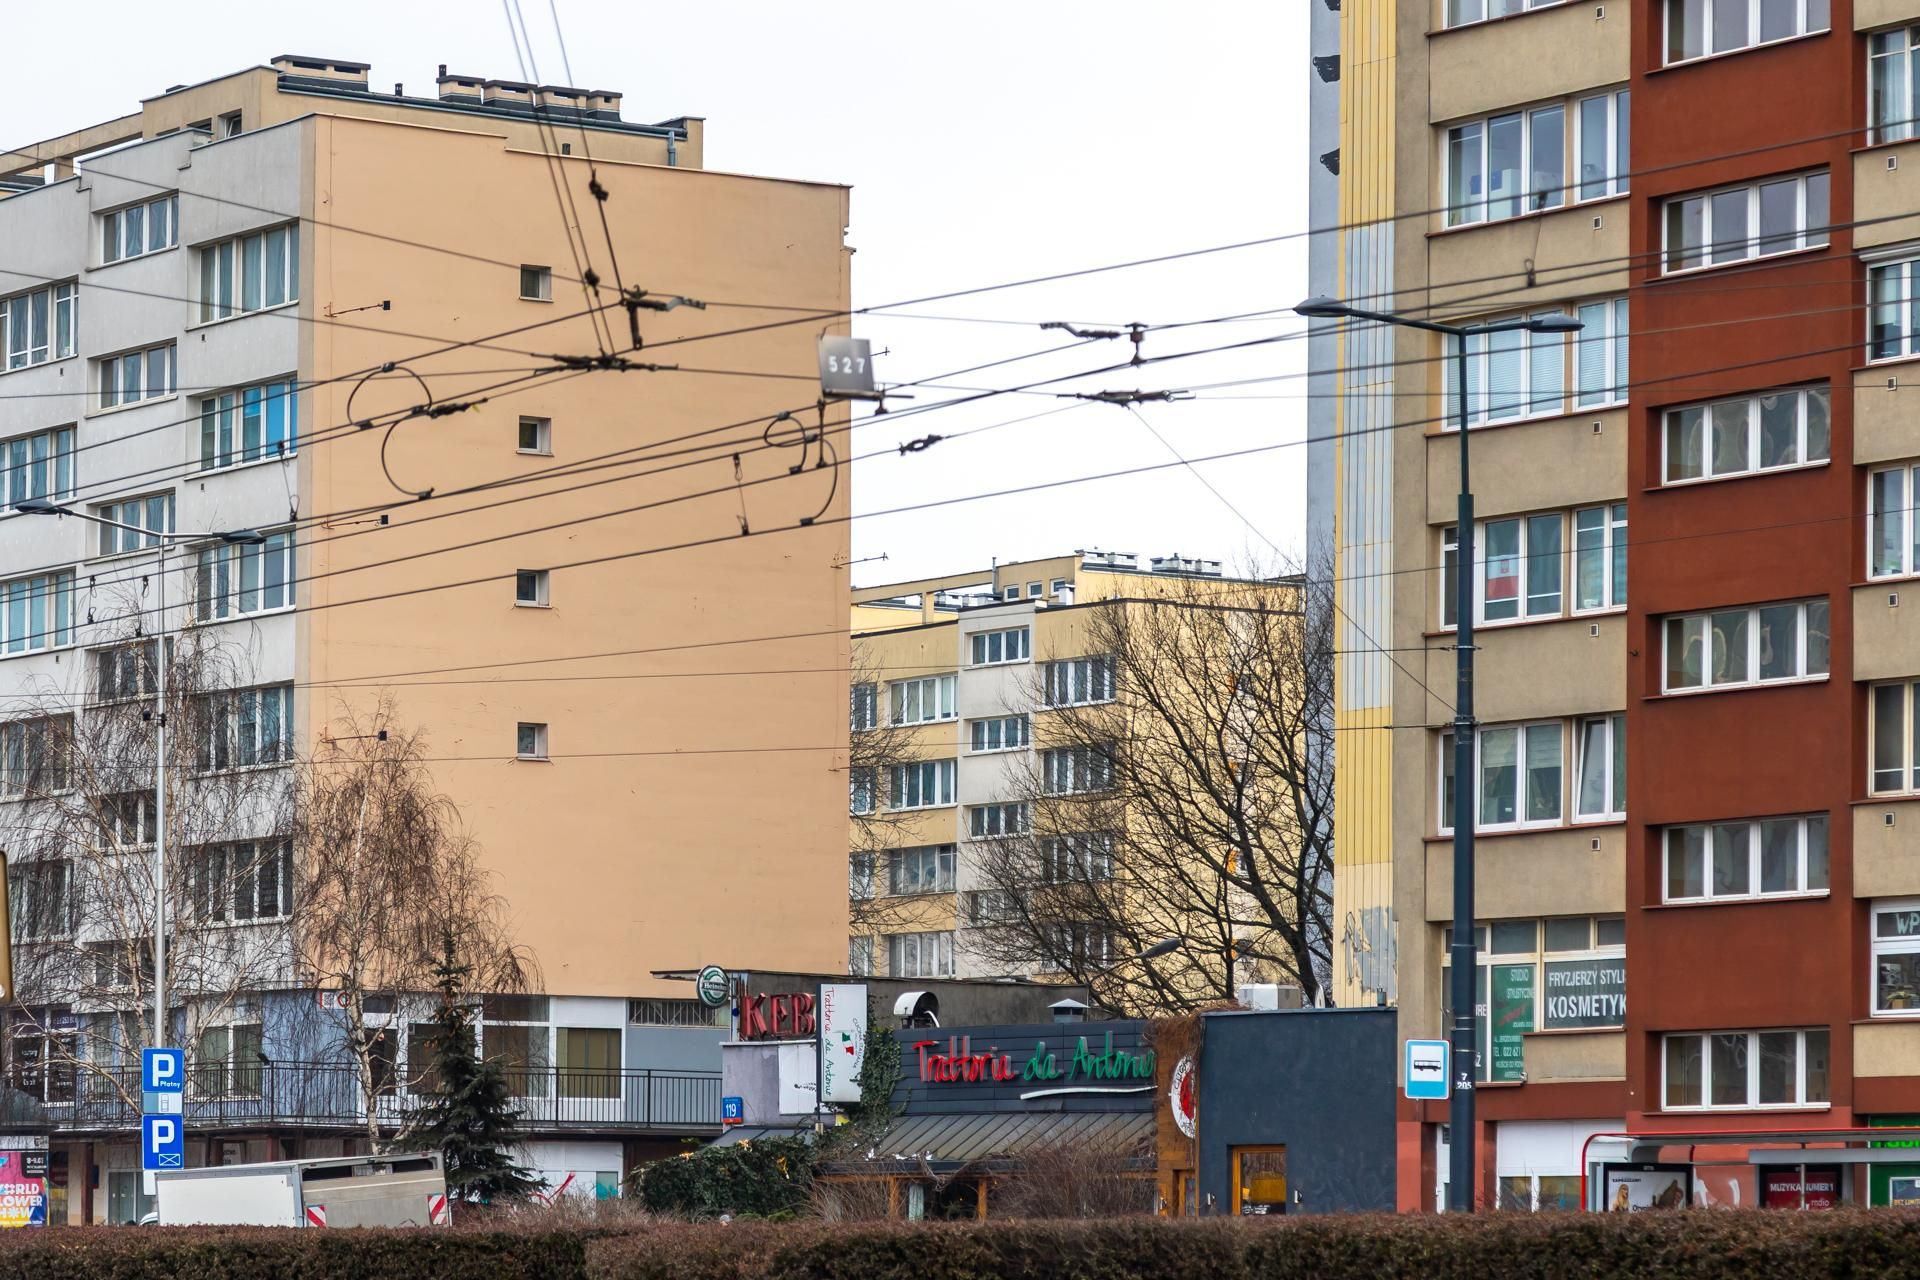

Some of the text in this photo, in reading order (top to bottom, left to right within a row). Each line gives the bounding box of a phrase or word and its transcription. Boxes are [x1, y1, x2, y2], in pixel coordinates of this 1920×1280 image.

[828, 355, 865, 374] 527
[1549, 970, 1598, 987] FRYZJERZY
[824, 987, 836, 1097] Trattoria da Antonio
[912, 1035, 1019, 1082] Trattoria
[1023, 1041, 1063, 1081] da
[152, 1053, 175, 1087] P
[1461, 1072, 1468, 1081] 7
[725, 1103, 737, 1118] 119
[152, 1120, 175, 1154] P
[1769, 1183, 1801, 1193] MUZYKA
